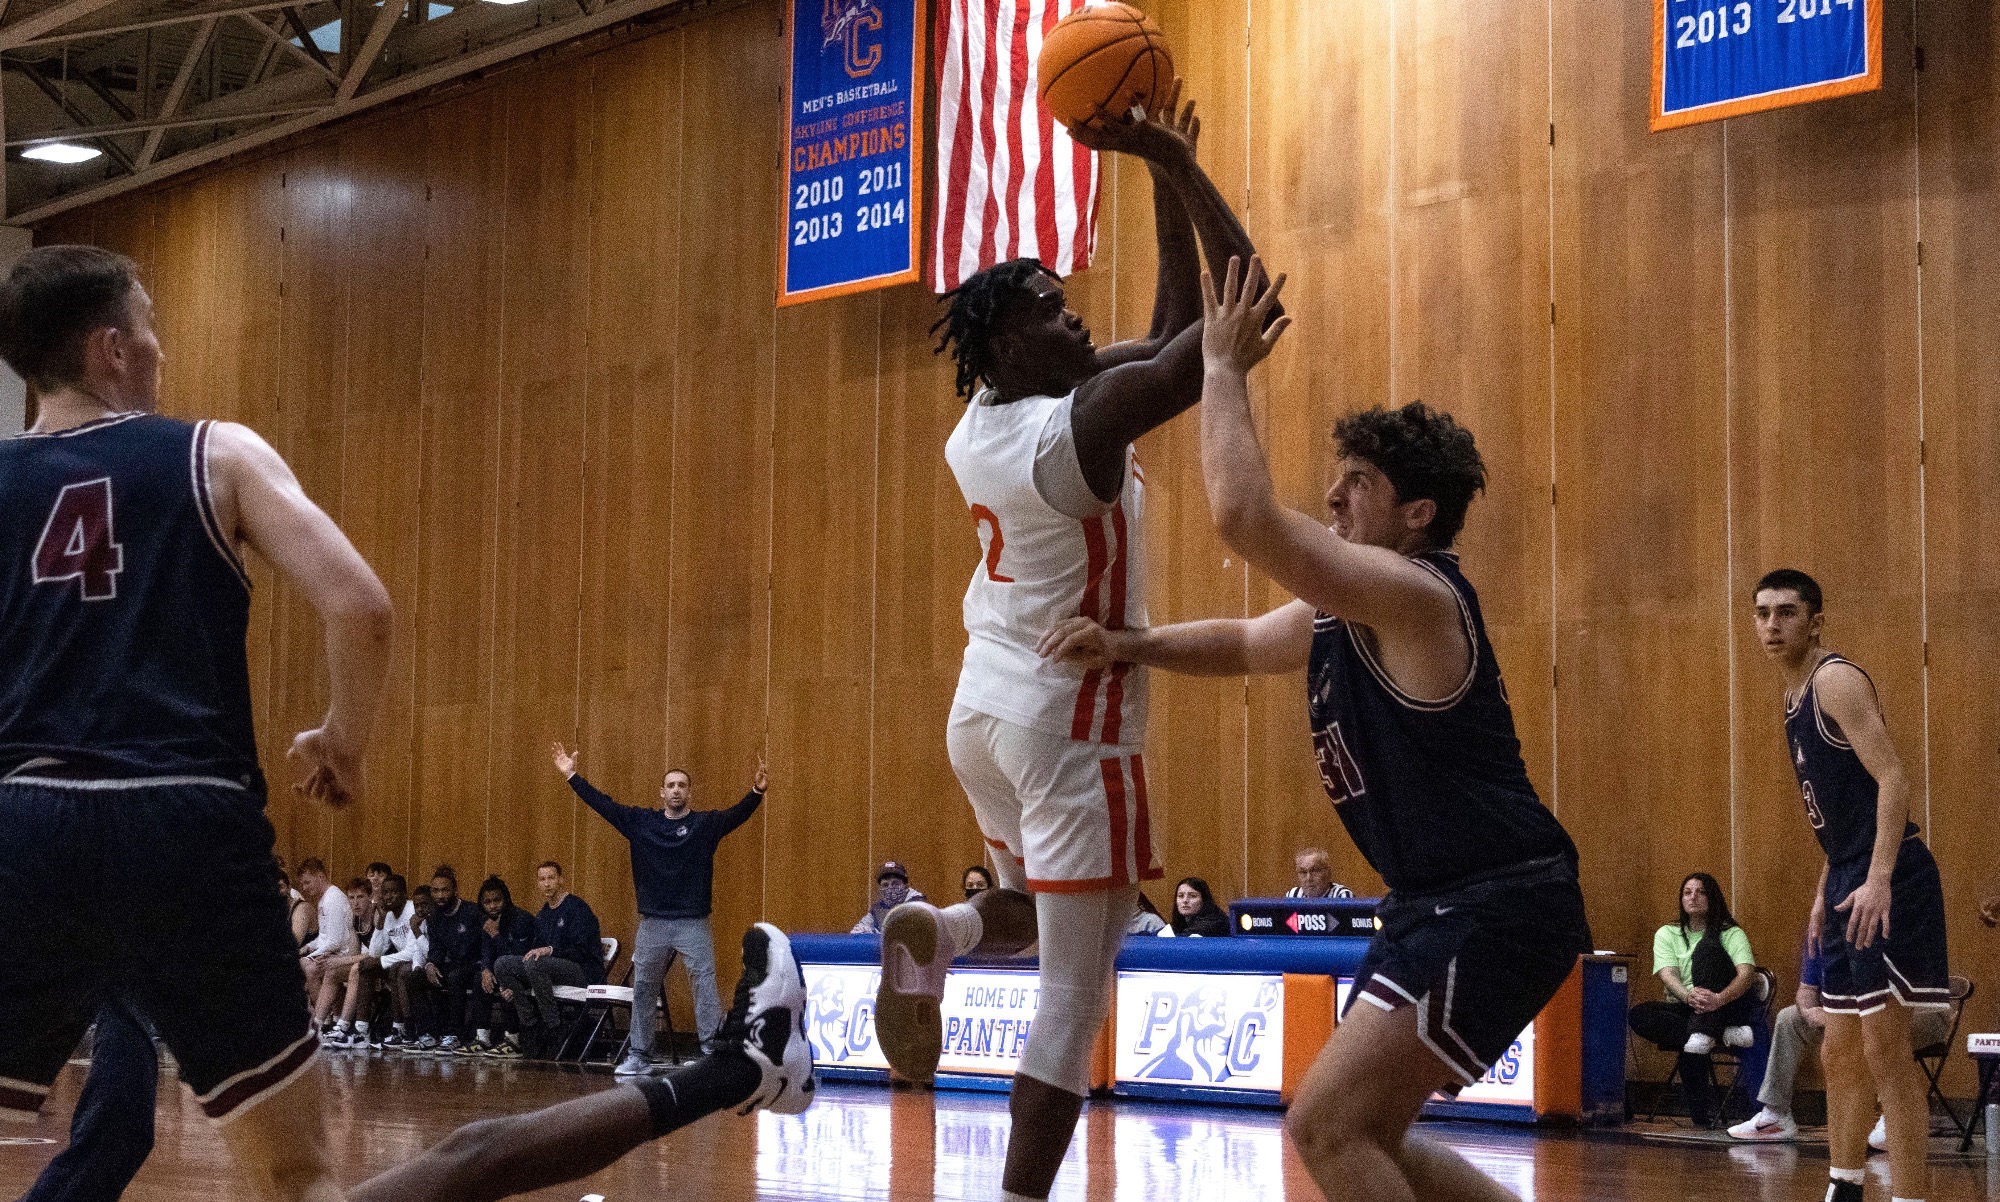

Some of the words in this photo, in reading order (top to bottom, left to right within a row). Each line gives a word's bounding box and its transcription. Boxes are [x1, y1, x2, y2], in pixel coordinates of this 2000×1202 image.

[1676, 1, 1751, 49] 2013
[795, 115, 838, 139] SKYLINE
[842, 101, 905, 128] CONFERENCE
[802, 94, 834, 114] MEN'S
[836, 79, 898, 105] BASKETBALL
[794, 122, 905, 172] CHAMPIONS
[796, 176, 843, 210] 2010
[858, 162, 902, 195] 2011
[794, 212, 842, 246] 2013
[856, 199, 905, 232] 2014
[32, 477, 123, 600] 4
[970, 502, 1015, 583] 2
[1311, 721, 1366, 804] 31
[1802, 780, 1825, 829] 3
[1252, 917, 1273, 928] BONUS
[1297, 914, 1326, 931] POSS
[1351, 917, 1373, 928] BONUS
[964, 986, 1007, 1009] HOME
[1009, 987, 1028, 1009] OF
[942, 1016, 1031, 1057] PANTH
